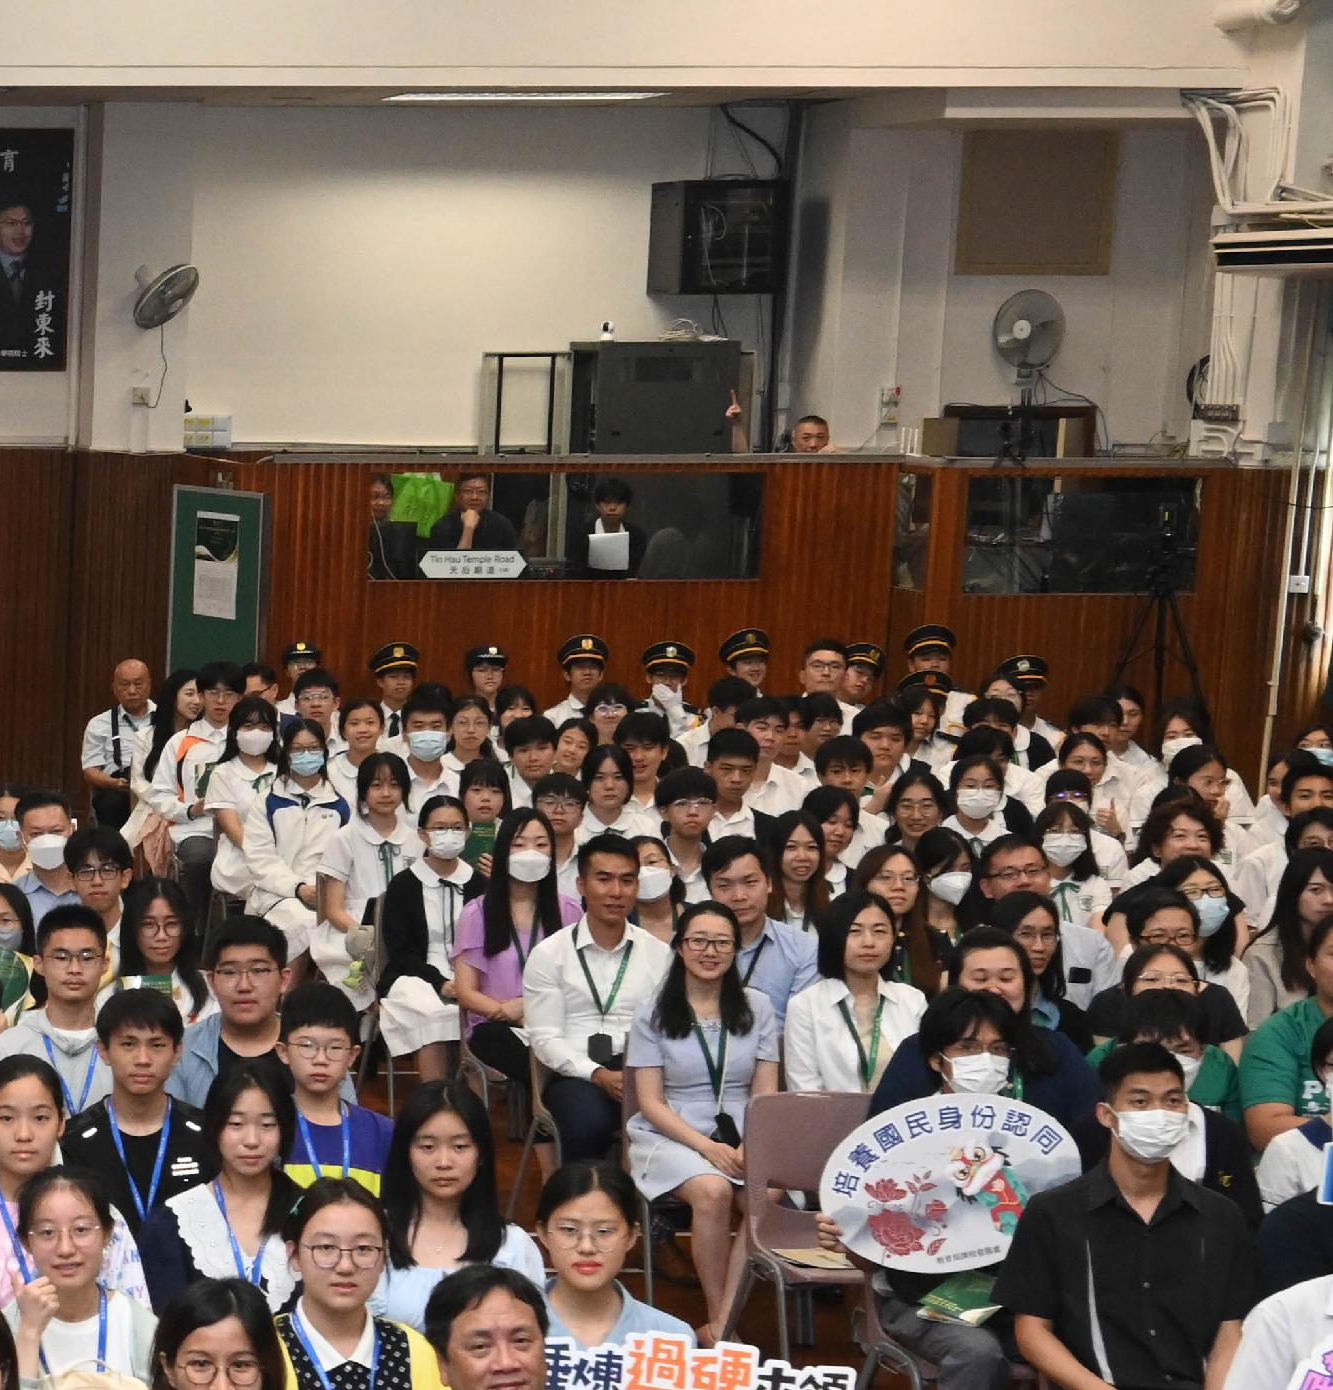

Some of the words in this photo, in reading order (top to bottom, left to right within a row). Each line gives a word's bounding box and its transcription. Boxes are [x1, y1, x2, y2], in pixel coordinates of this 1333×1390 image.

[430, 555, 443, 563] Tin
[444, 555, 461, 563] Hau
[462, 555, 493, 565] Temple
[494, 555, 515, 563] Road
[831, 1104, 1065, 1199] 培養國民身份認同
